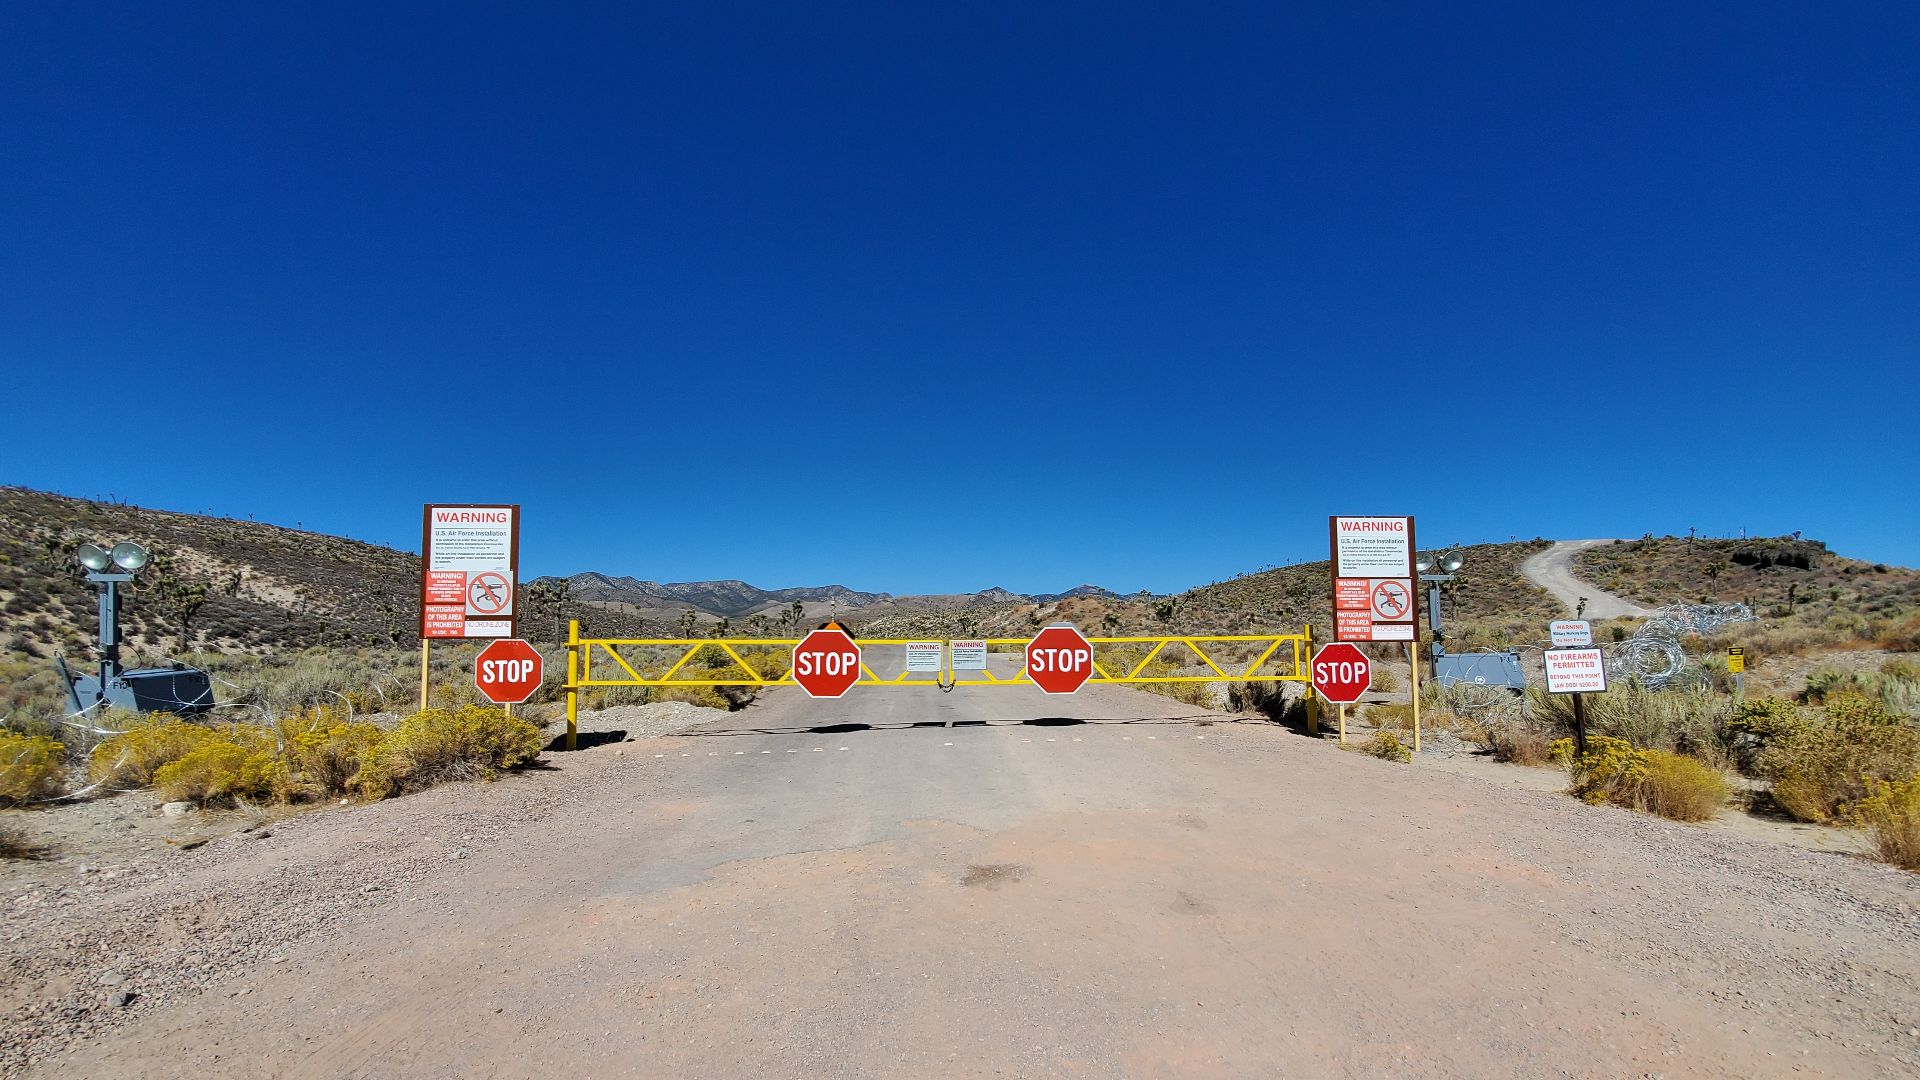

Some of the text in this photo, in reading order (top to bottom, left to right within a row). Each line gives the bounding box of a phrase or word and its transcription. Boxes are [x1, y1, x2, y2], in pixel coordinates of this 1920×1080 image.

[436, 512, 507, 523] WARNING
[1340, 521, 1403, 532] WARNING
[798, 652, 856, 675] STOP
[1032, 648, 1088, 672] STOP
[1553, 661, 1595, 669] PERMITTED
[1560, 653, 1598, 661] FIREARMS
[483, 660, 533, 683] STOP
[1316, 662, 1366, 684] STOP
